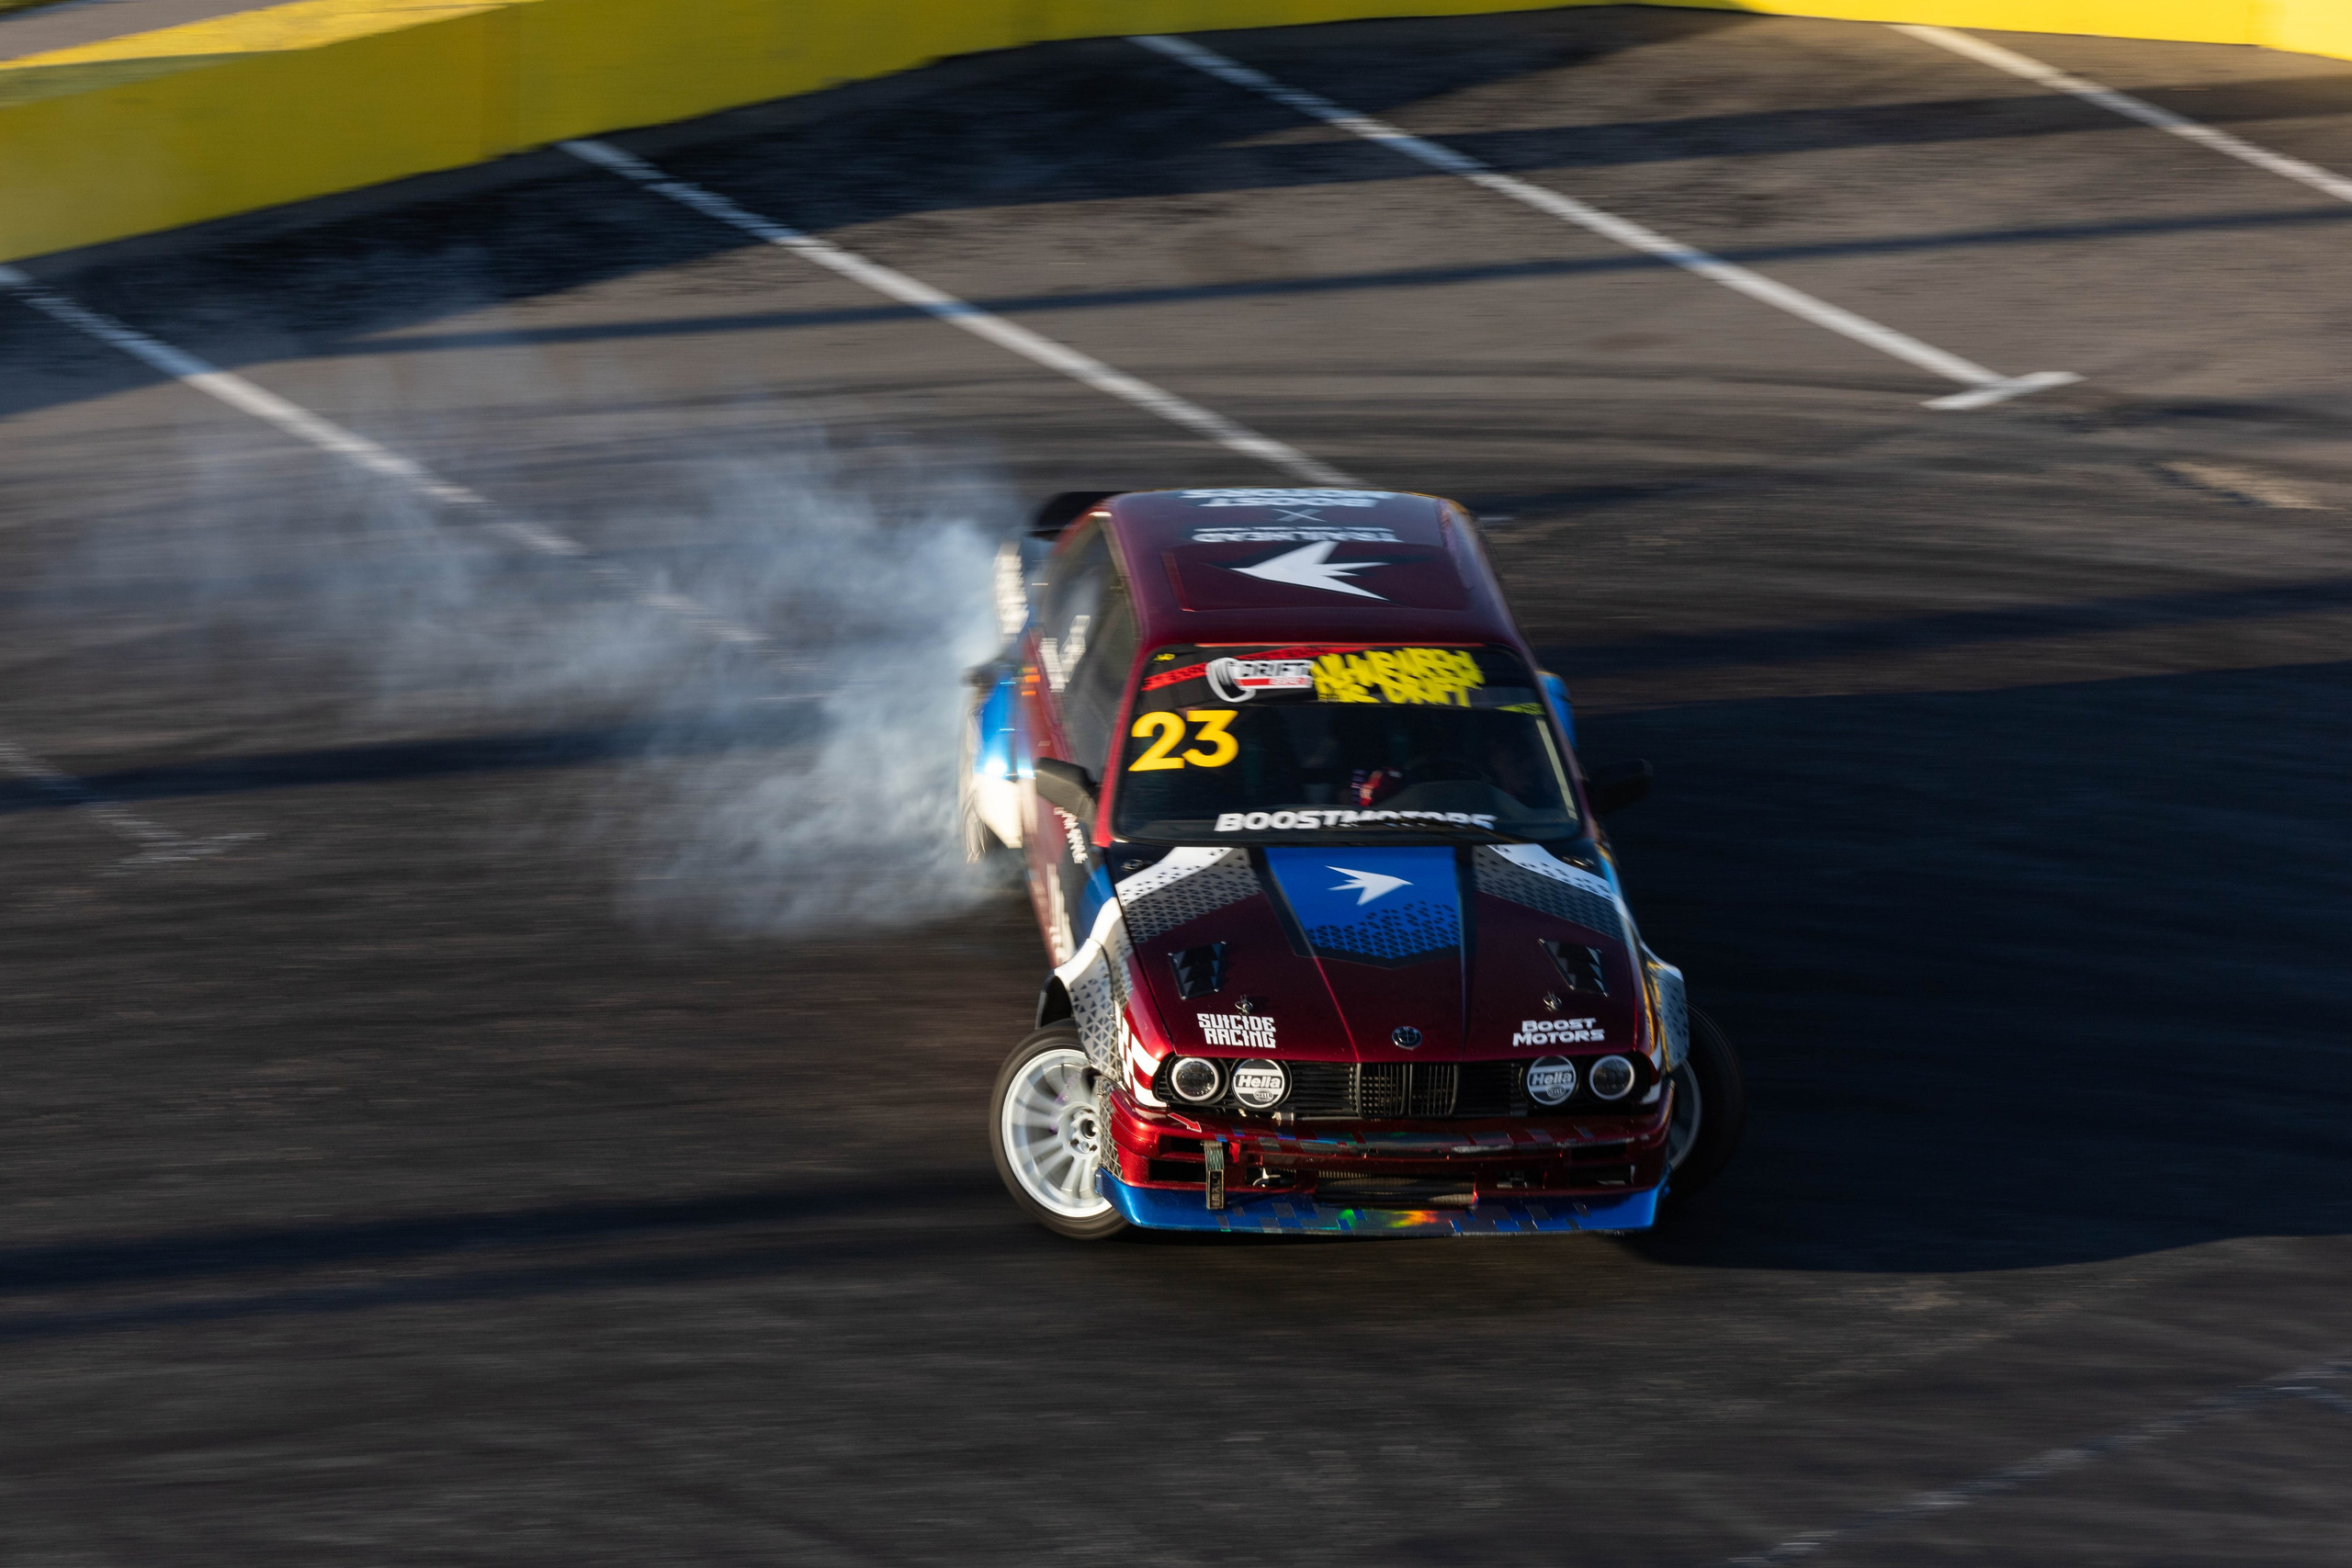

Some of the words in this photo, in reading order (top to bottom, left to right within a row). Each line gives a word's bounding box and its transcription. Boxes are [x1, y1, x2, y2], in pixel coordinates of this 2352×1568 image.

[1128, 710, 1238, 771] 23
[1197, 1013, 1276, 1032] SUICIDE
[1521, 1018, 1597, 1033] BOOST
[1204, 1028, 1276, 1048] RACING
[1512, 1029, 1605, 1046] MOTORS
[1238, 1075, 1281, 1089] Hella
[1532, 1072, 1572, 1087] Hella
